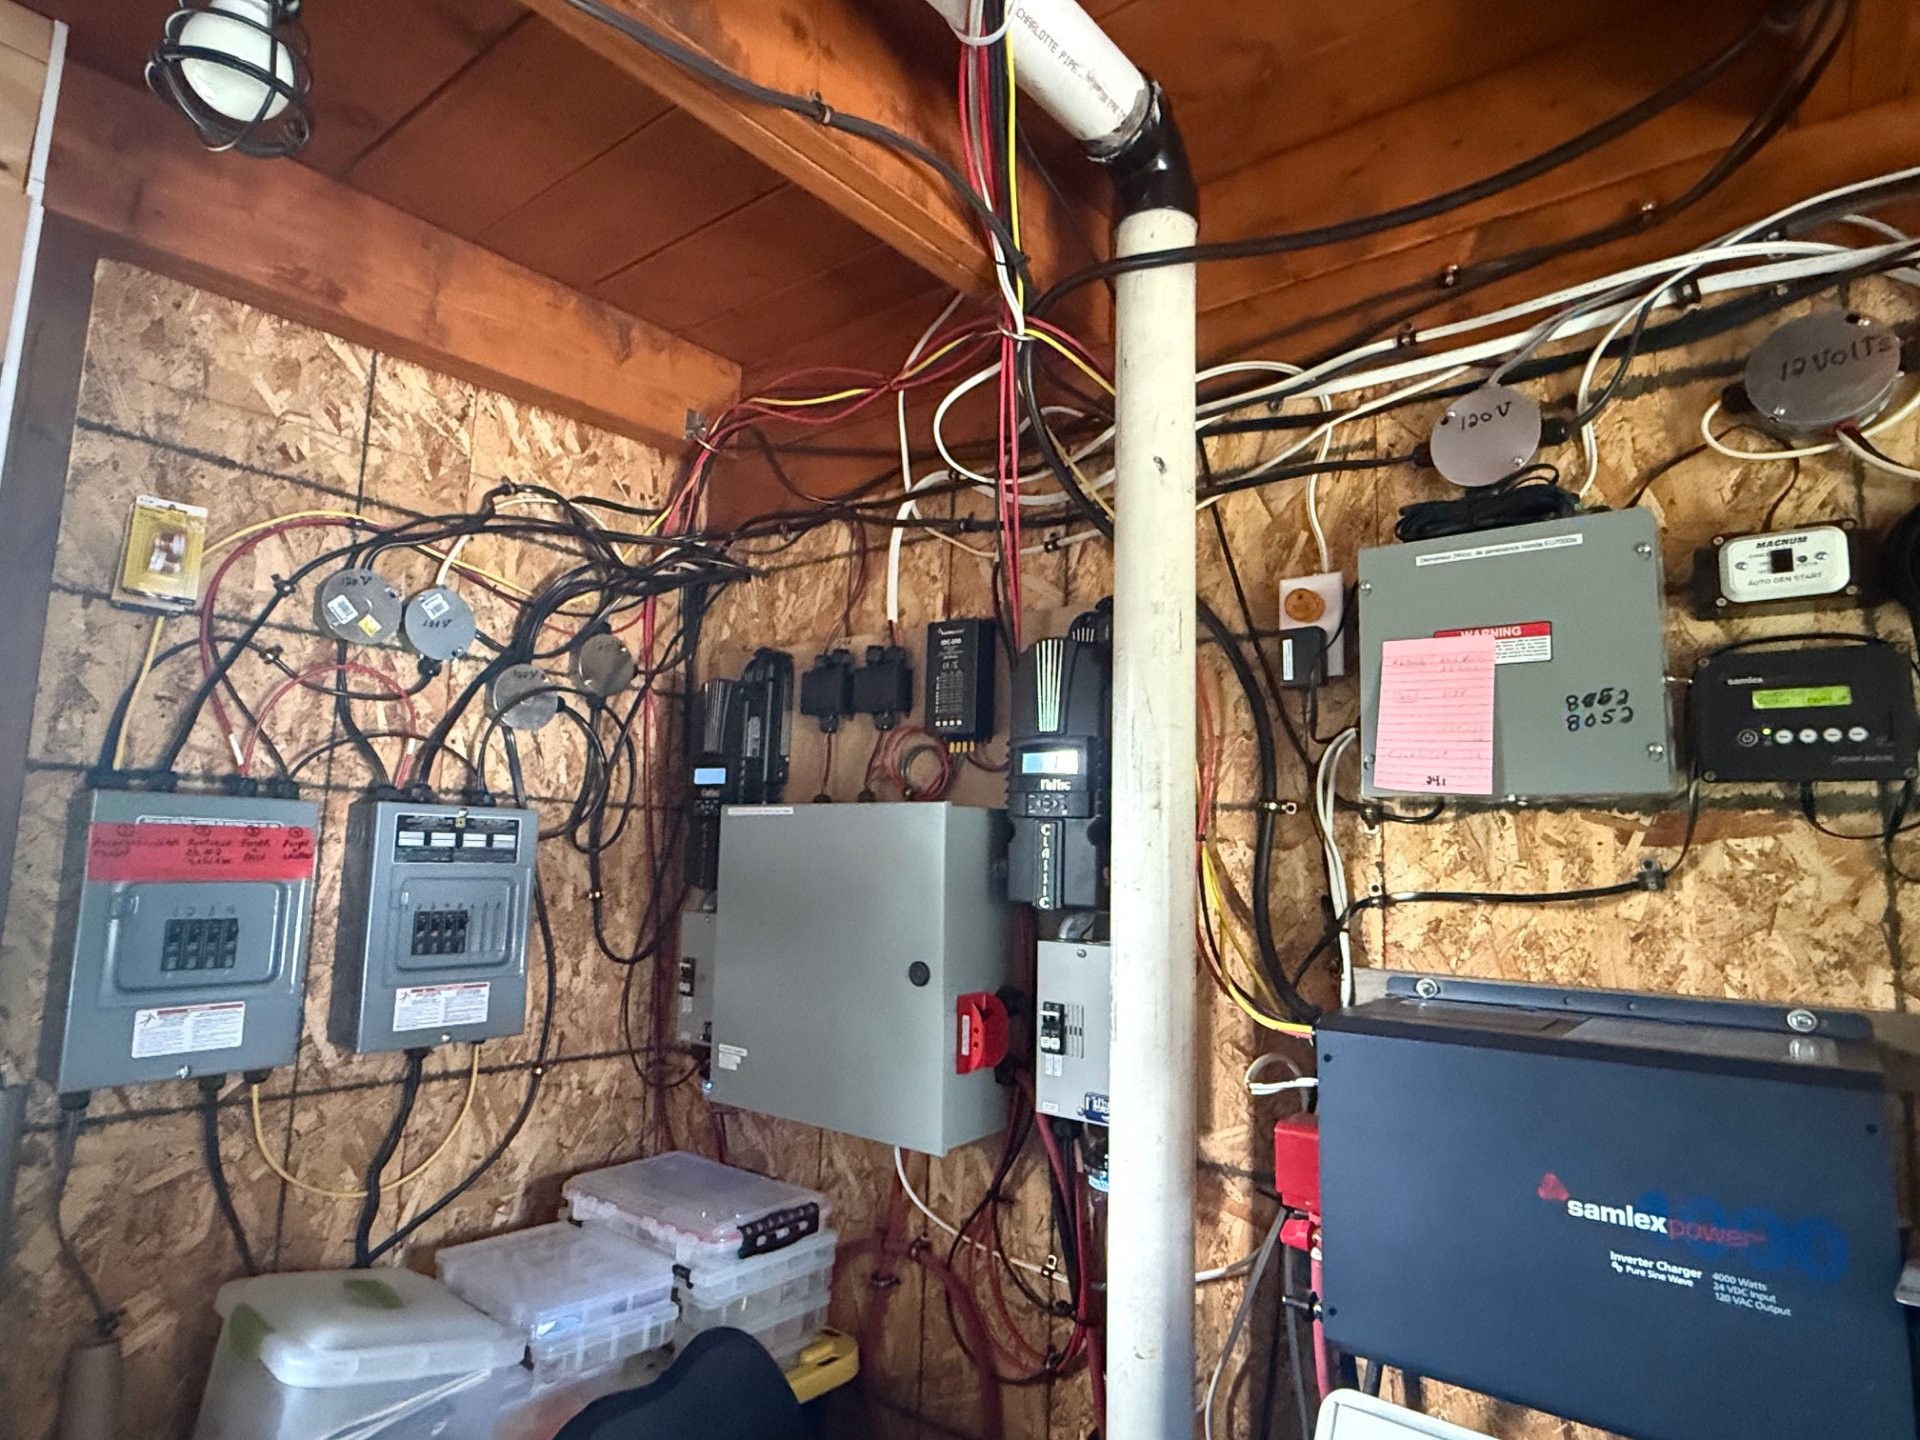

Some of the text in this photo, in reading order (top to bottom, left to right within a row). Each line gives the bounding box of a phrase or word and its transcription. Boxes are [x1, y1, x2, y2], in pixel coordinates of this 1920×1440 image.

[1016, 7, 1081, 74] CHARLOTTE PIPE
[1780, 356, 1806, 382] 12
[1461, 401, 1512, 431] 120 V
[1755, 536, 1808, 550] MAGNUM
[1748, 571, 1823, 587] AUTO GEN START
[1460, 626, 1522, 638] WARNING
[1566, 705, 1634, 732] 8052
[1567, 1199, 1757, 1248] samlex power
[1609, 1251, 1703, 1279] Inverter Charger
[1625, 1265, 1695, 1288] Pure Sine Wave
[1711, 1272, 1768, 1292] 4000 Watts
[1712, 1281, 1777, 1304] 24 VDC Input
[1714, 1292, 1792, 1317] 120 VAC Output
